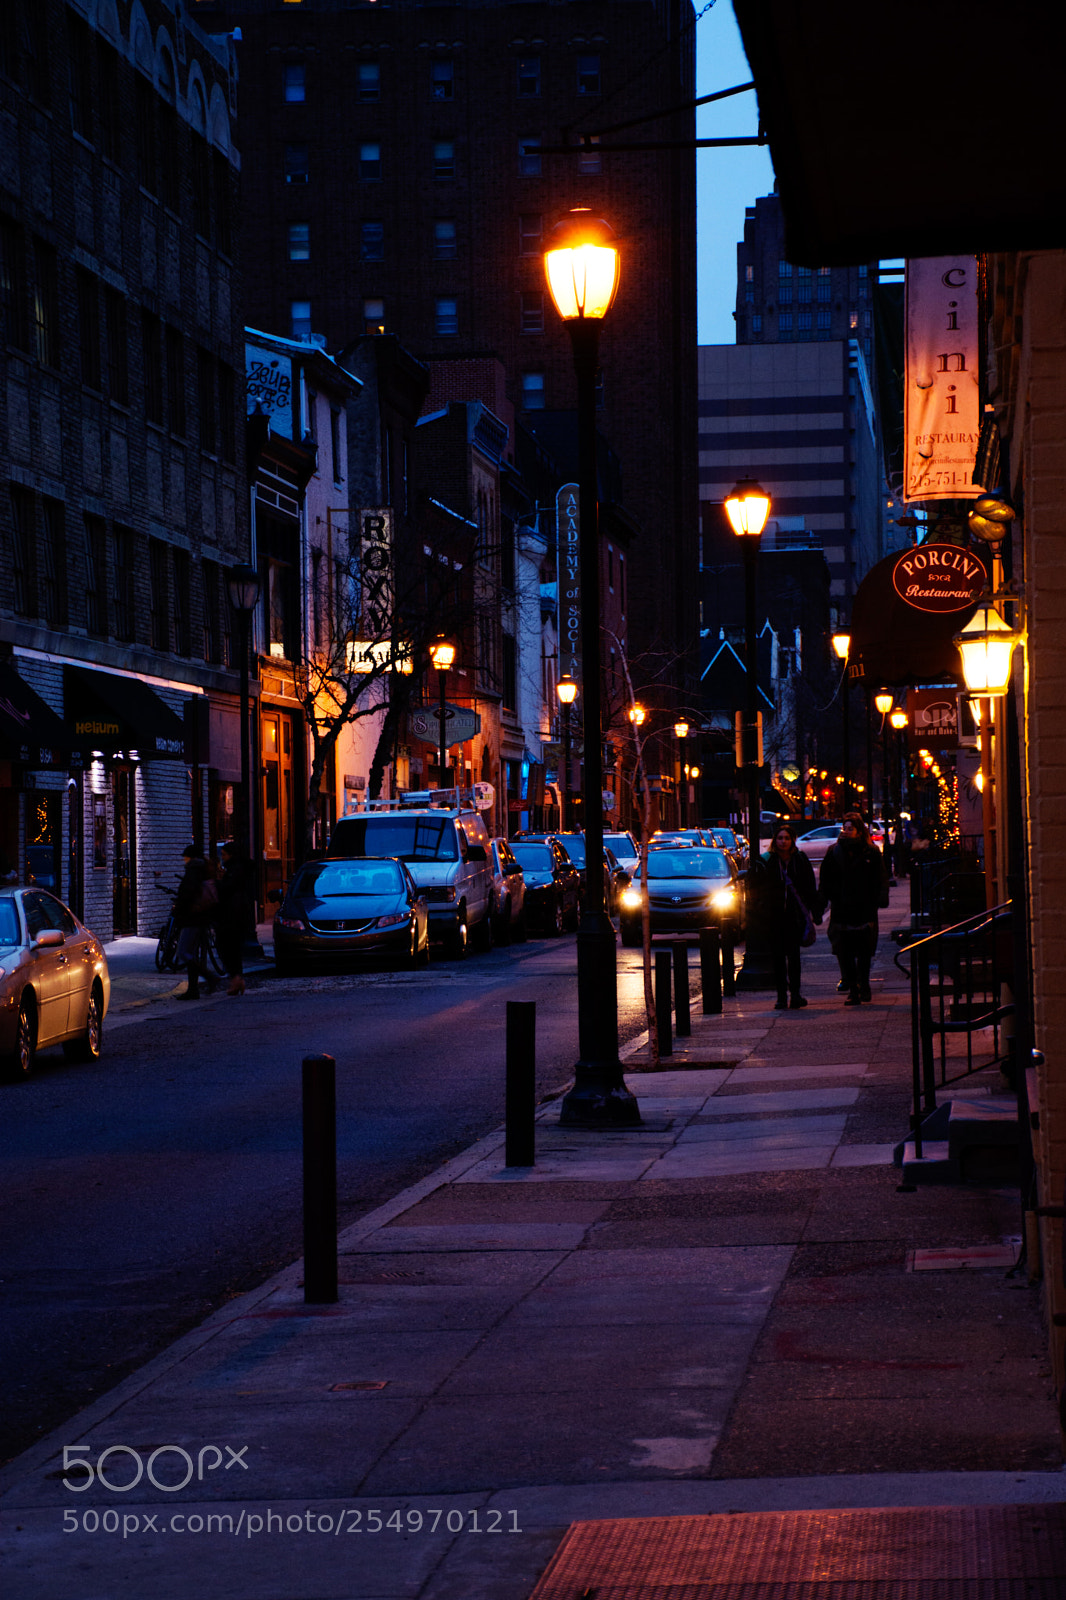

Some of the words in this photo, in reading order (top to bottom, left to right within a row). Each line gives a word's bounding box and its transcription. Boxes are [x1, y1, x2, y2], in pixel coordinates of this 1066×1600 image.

[566, 493, 579, 580] ACADEMY
[363, 516, 389, 632] ROXY
[902, 550, 980, 580] PORCINI
[566, 587, 579, 599] of
[567, 605, 579, 679] SOCIAL
[76, 721, 119, 734] Helium
